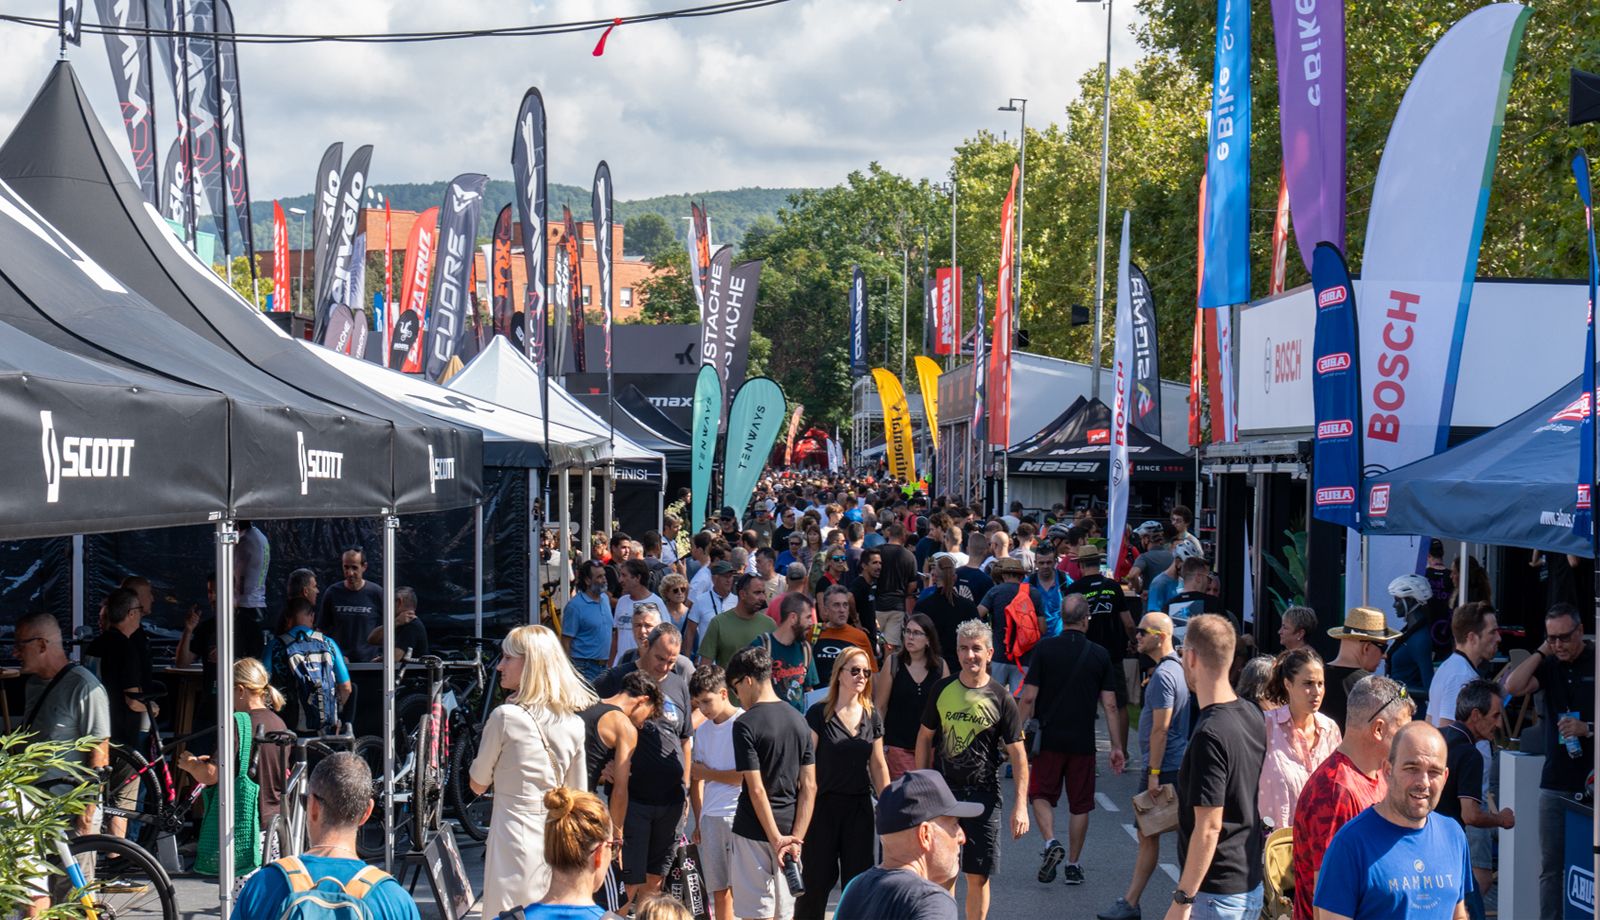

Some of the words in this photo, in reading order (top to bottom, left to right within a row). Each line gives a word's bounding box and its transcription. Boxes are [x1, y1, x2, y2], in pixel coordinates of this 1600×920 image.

[331, 171, 363, 305] ervélo
[415, 227, 432, 288] CRUZ
[435, 227, 466, 362] CUORE
[703, 263, 723, 368] USTACHE
[1275, 338, 1302, 384] BOSCH
[1367, 290, 1420, 443] BOSCH
[1115, 360, 1125, 447] BOSCH
[61, 436, 135, 477] SCOTT
[307, 449, 344, 479] SCOTT
[738, 405, 765, 469] TENWAYS
[434, 457, 455, 480] SCOTT
[335, 605, 372, 614] TREK
[1388, 873, 1454, 893] MAMMUT
